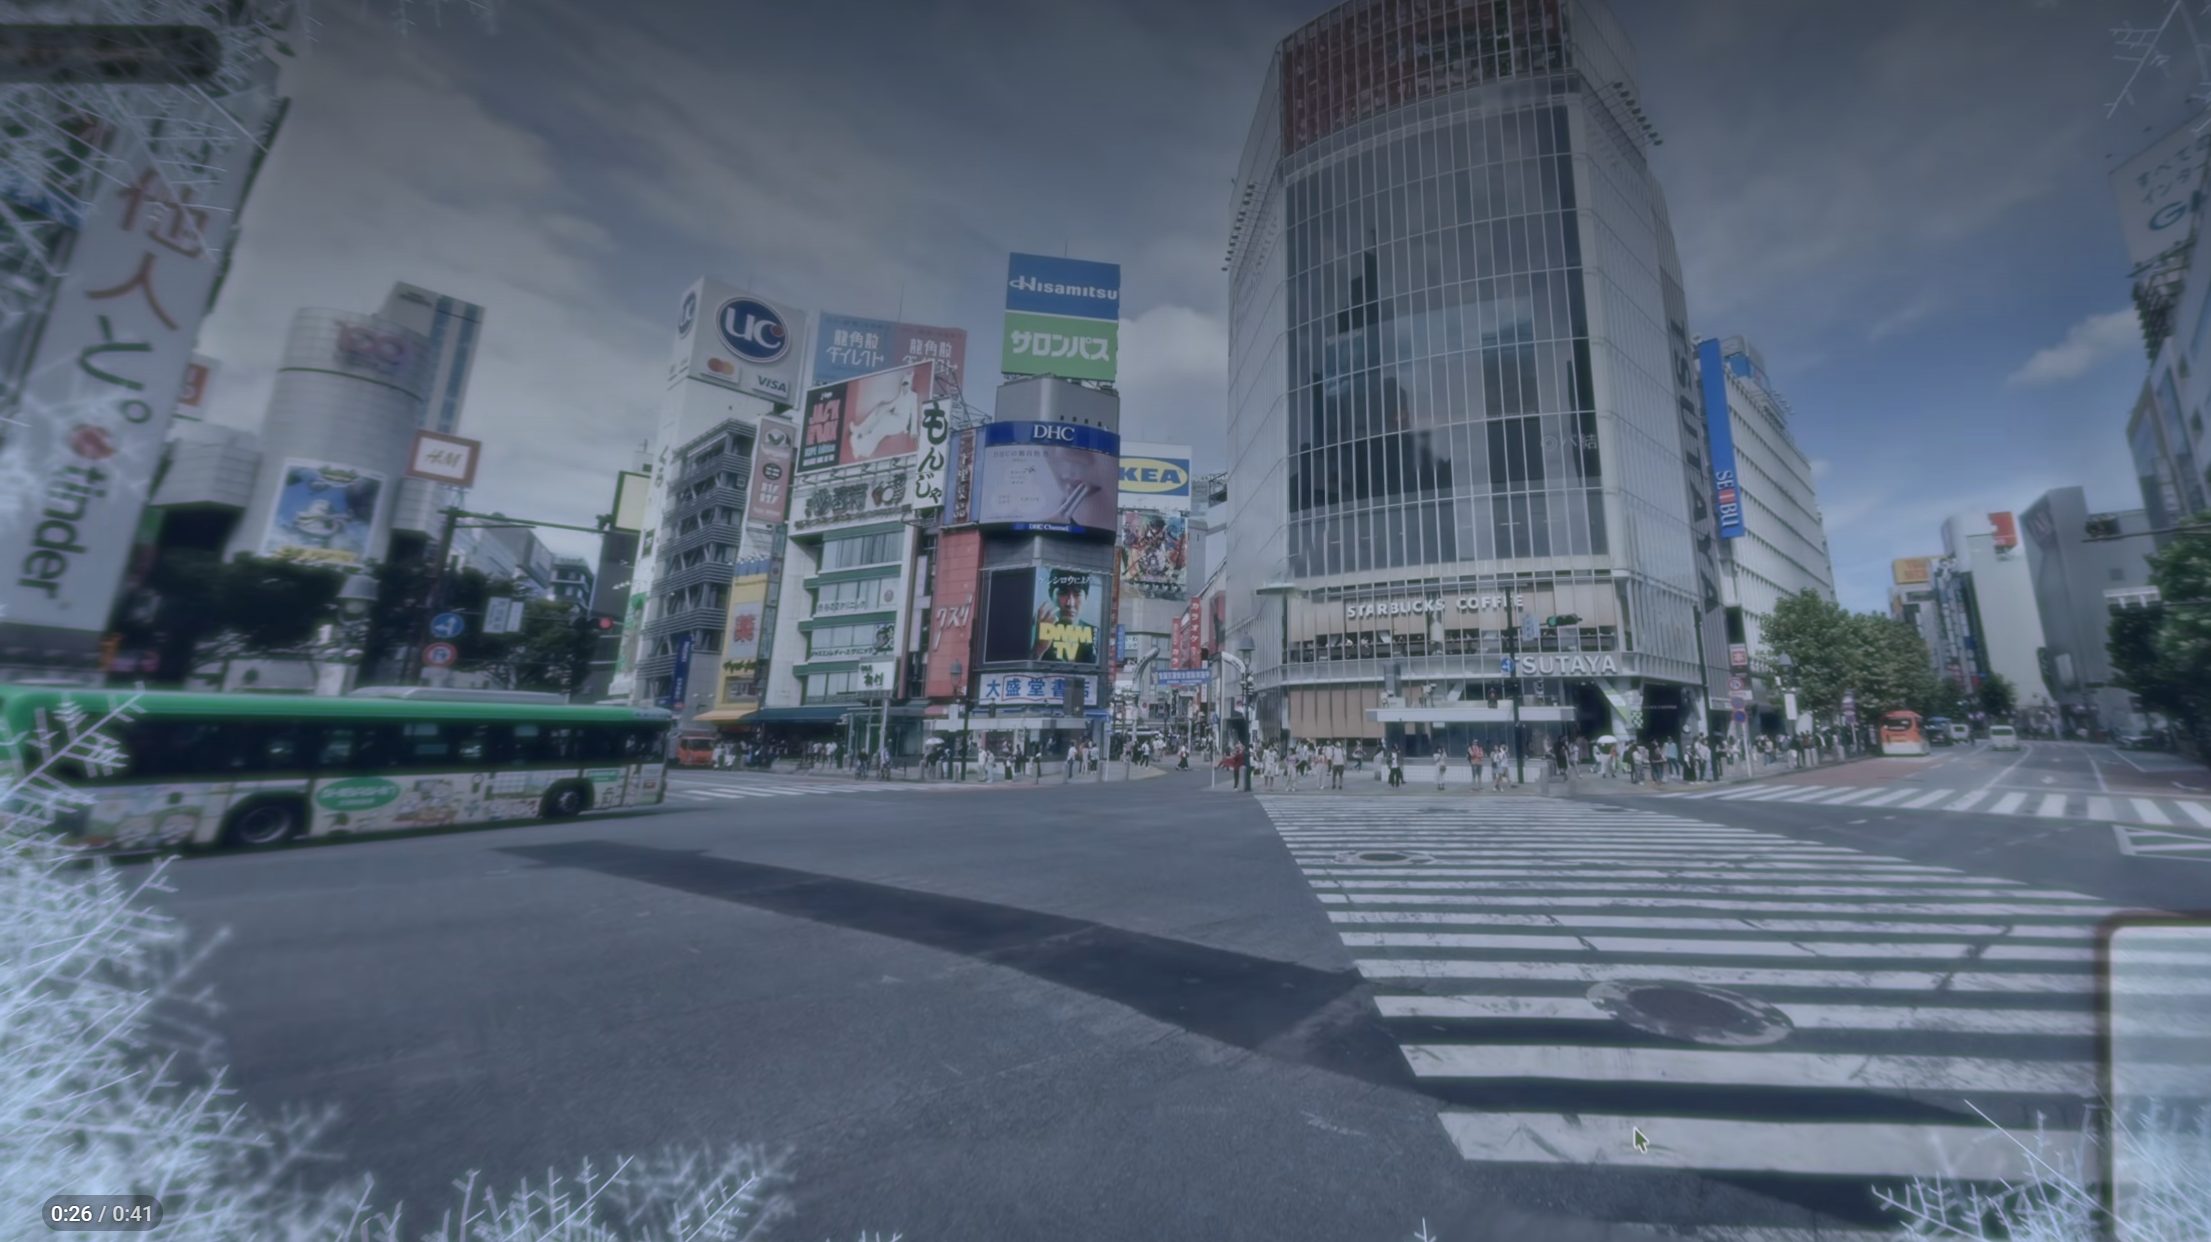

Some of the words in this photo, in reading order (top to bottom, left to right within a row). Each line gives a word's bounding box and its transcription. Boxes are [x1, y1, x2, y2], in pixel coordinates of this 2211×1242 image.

[1010, 275, 1118, 301] Hisamitsu
[724, 307, 781, 350] UC
[1010, 329, 1110, 362] サロンパス
[757, 375, 787, 393] VISA
[1033, 423, 1075, 441] DHC
[915, 400, 948, 504] もんじゃ
[1118, 467, 1181, 484] KEA
[1716, 470, 1739, 528] SEIBU
[18, 464, 108, 604] tinder
[1028, 523, 1042, 531] DHC
[1347, 598, 1446, 618] STARBUCKS
[1039, 622, 1093, 643] DMM
[1053, 641, 1079, 660] TV
